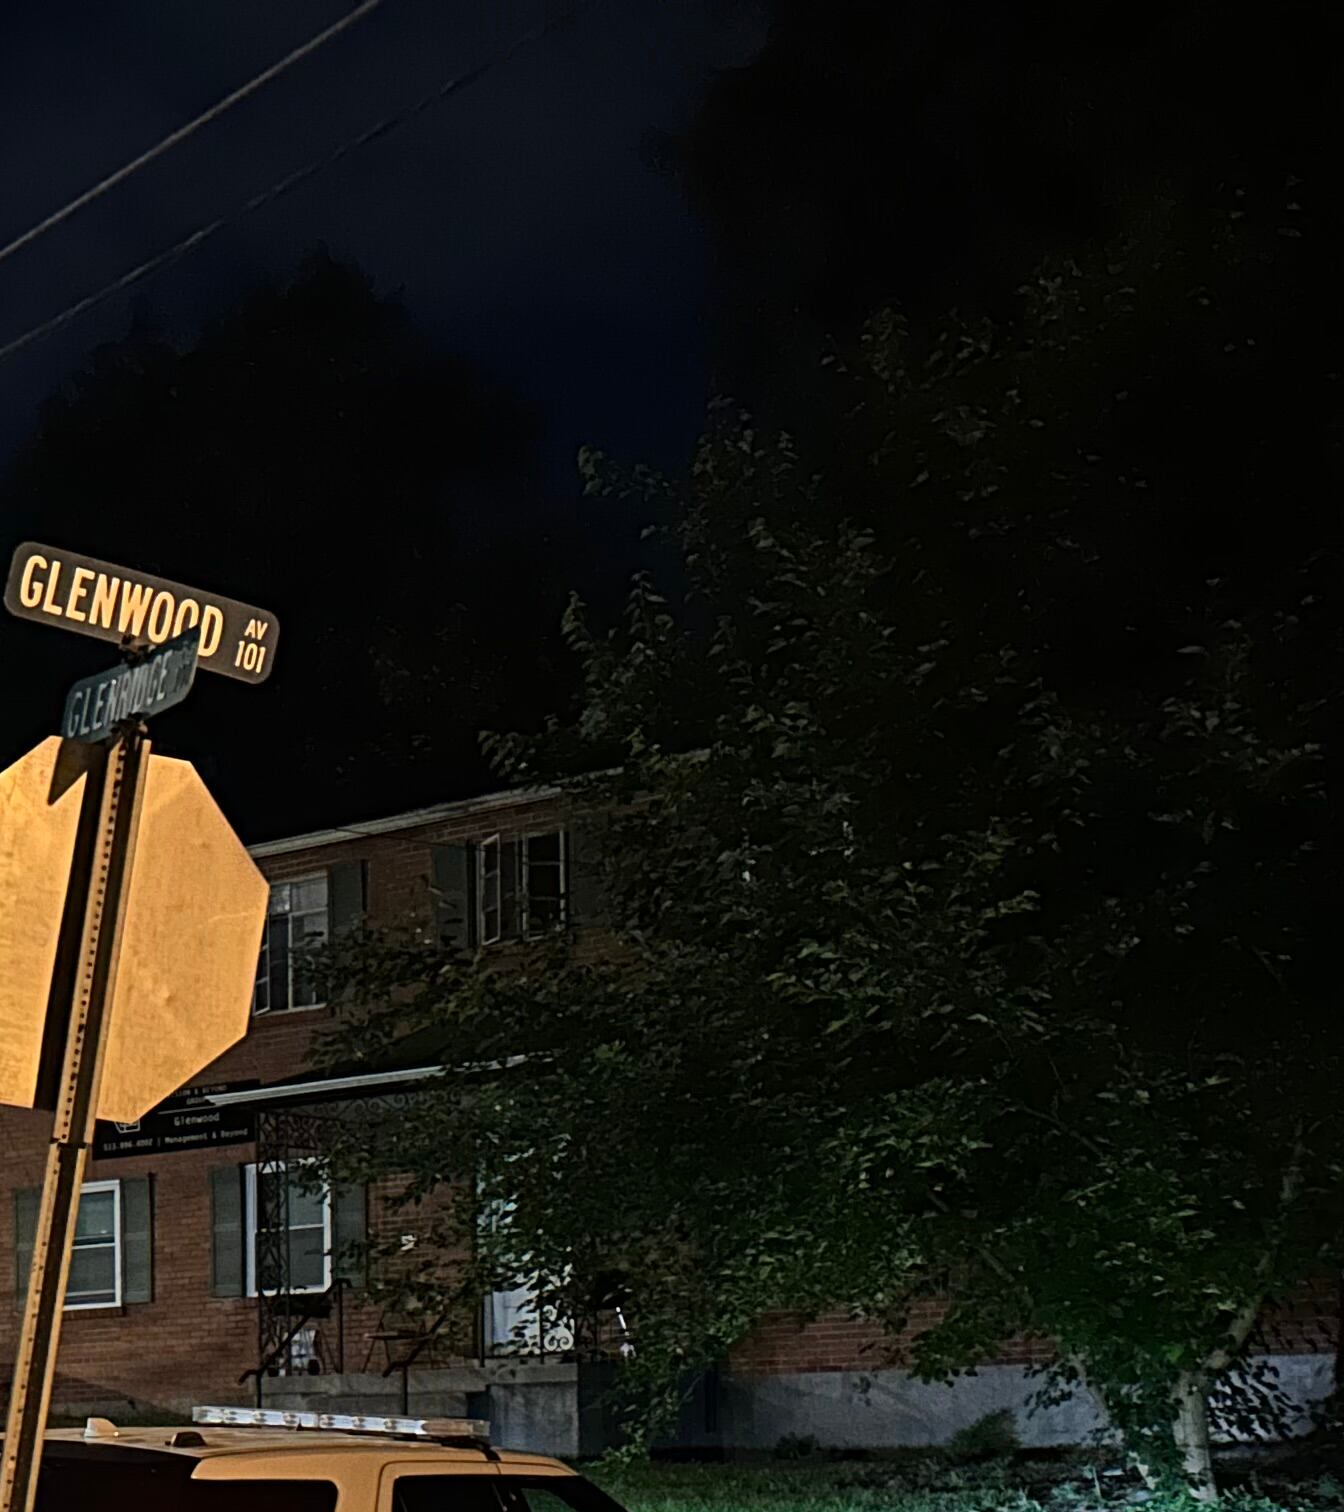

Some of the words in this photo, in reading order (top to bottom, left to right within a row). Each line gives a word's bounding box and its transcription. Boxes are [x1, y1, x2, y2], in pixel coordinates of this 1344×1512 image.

[20, 555, 224, 657] GLENWOOD
[244, 619, 269, 640] AV
[235, 641, 267, 674] 101
[173, 1112, 220, 1126] Glenwood
